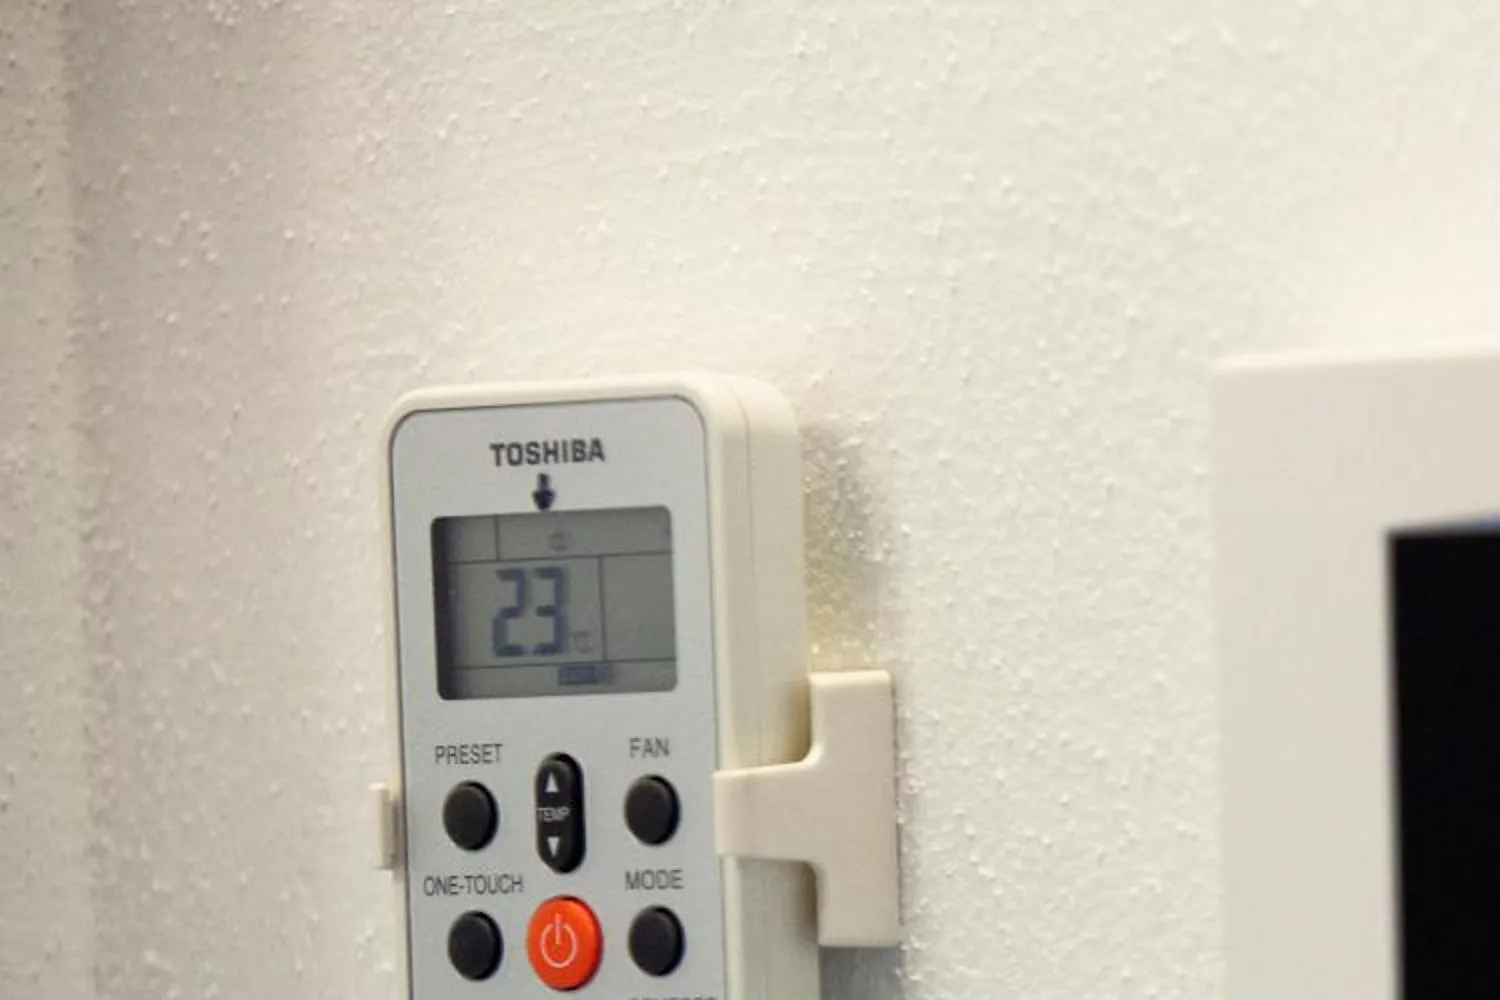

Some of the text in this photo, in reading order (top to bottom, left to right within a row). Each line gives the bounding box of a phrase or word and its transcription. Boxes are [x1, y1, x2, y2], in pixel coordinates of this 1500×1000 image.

[490, 437, 606, 467] TOSHIBA
[492, 566, 568, 657] 23
[435, 744, 503, 765] PRESET
[629, 738, 671, 758] FAN
[537, 807, 570, 822] TEMP
[423, 873, 524, 896] ONE-TOUCH
[625, 869, 684, 891] MODE
